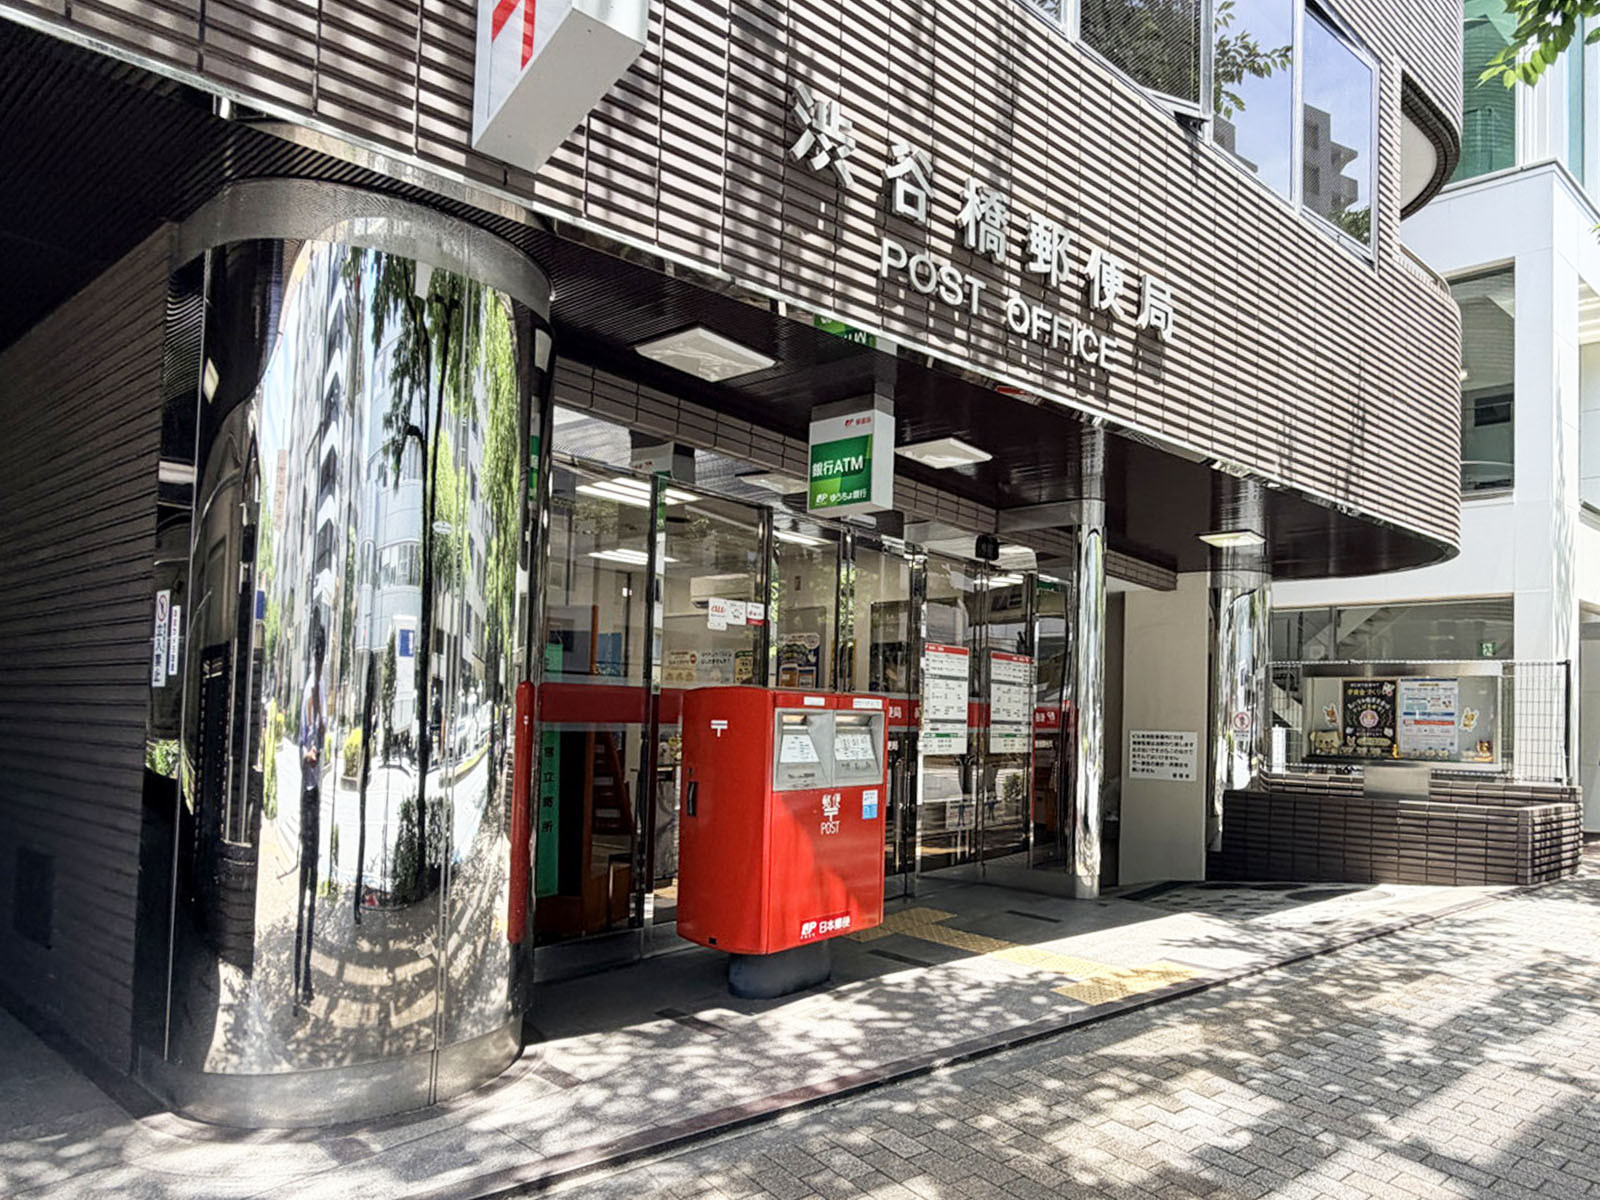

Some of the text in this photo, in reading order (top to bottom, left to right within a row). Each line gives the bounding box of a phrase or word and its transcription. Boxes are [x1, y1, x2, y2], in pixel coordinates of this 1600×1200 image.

[787, 84, 1176, 343] 渋谷橋郵便局
[879, 236, 1119, 370] POST OFFICE
[812, 455, 864, 478] 銀行ATM
[822, 792, 841, 809] 郵便
[821, 820, 841, 835] POST
